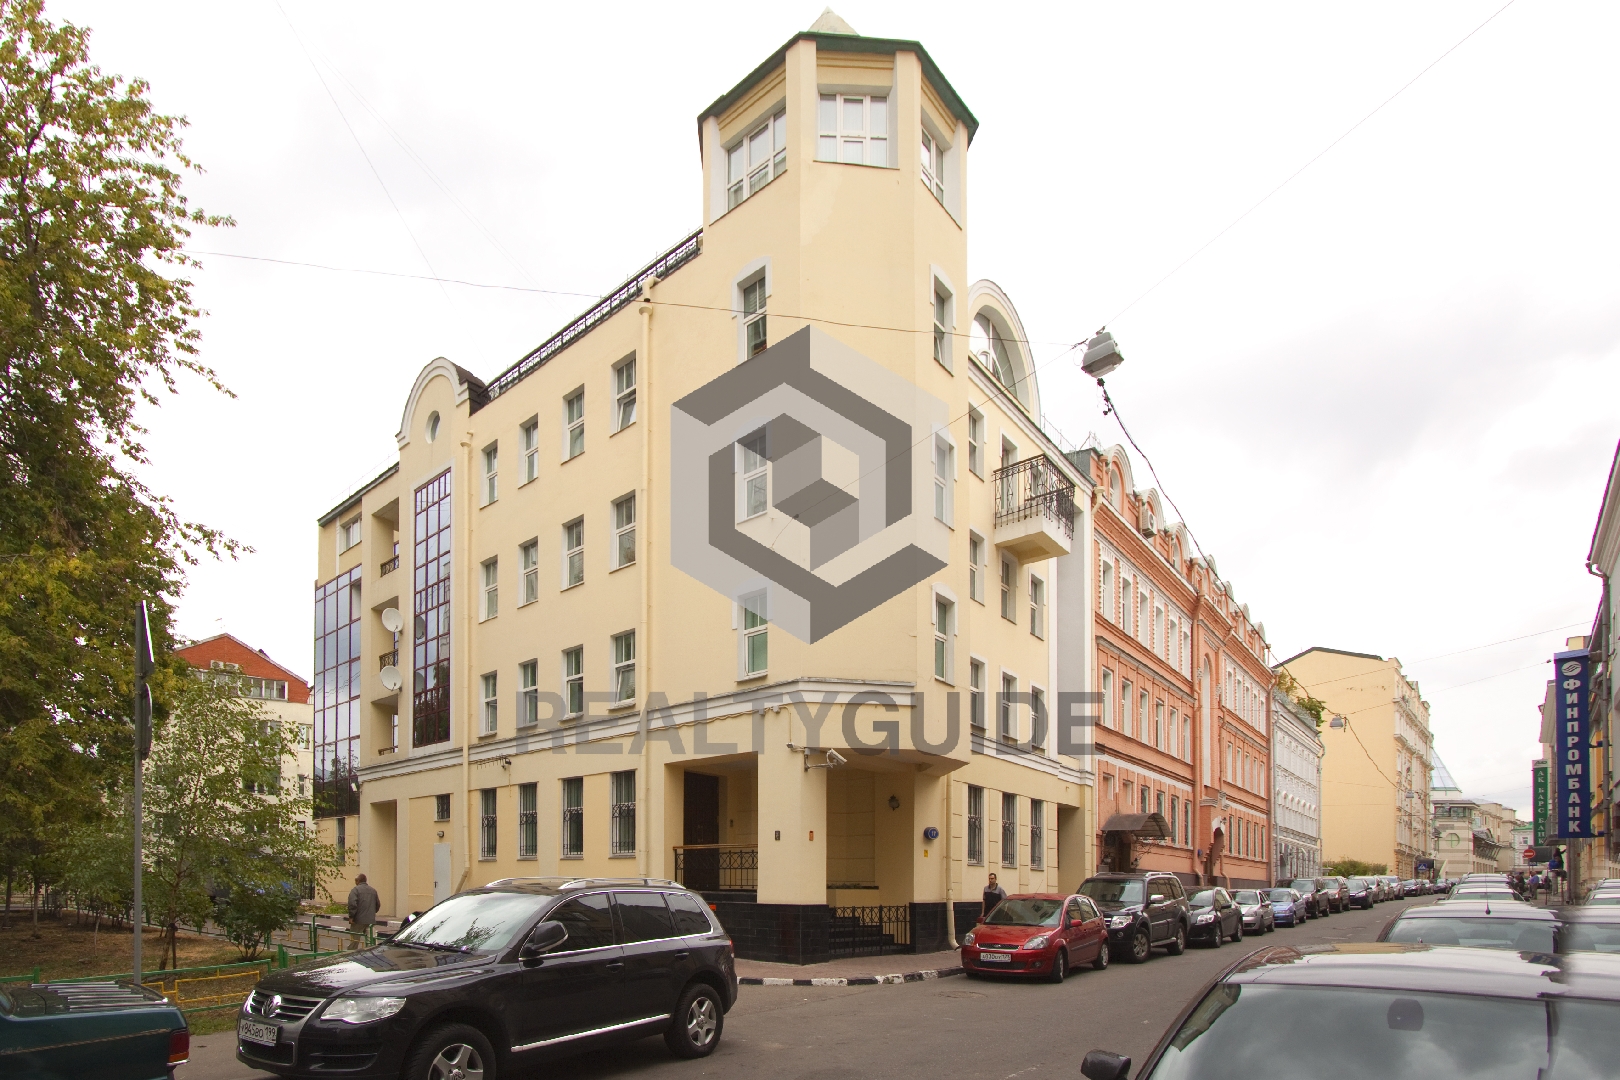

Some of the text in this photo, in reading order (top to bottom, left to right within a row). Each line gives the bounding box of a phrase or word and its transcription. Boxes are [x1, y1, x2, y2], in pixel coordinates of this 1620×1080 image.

[1562, 678, 1582, 833] ФИНПРОМБАНК
[1537, 770, 1544, 783] АК
[1537, 787, 1545, 814] БАРС
